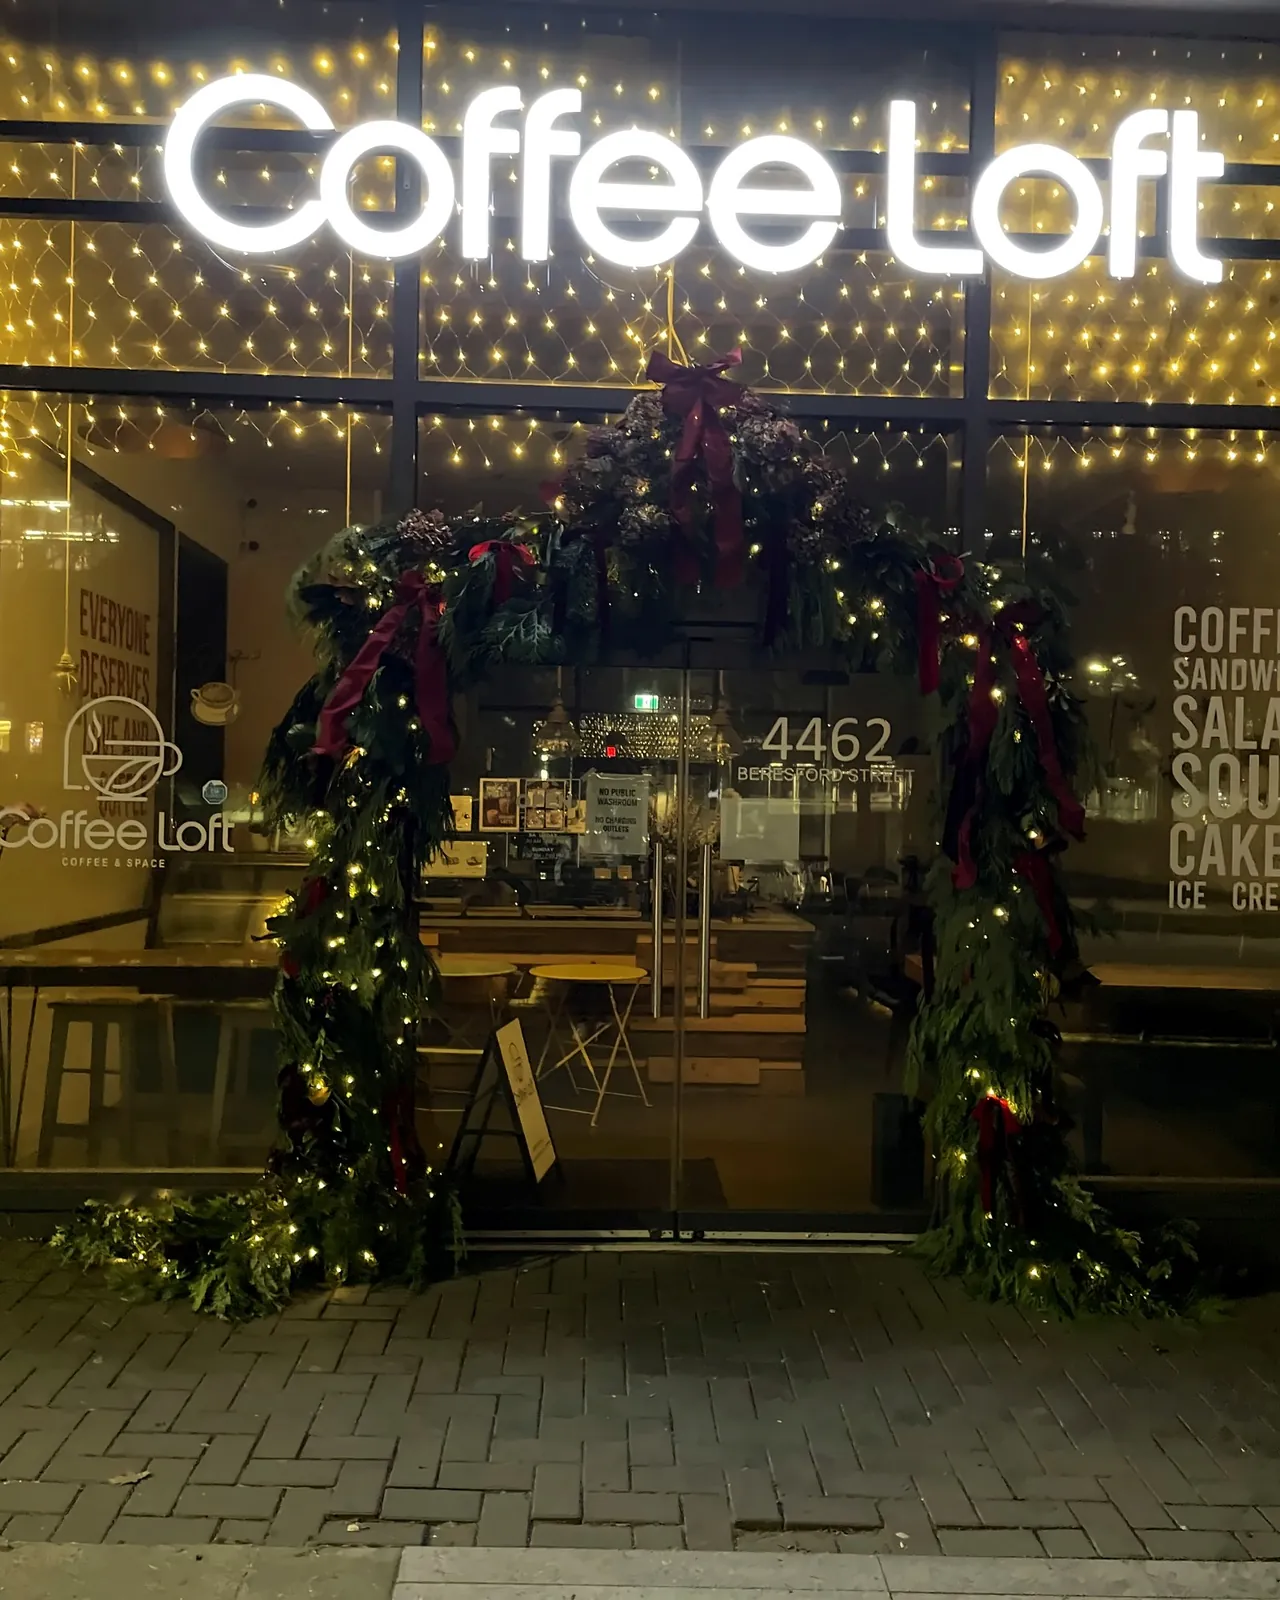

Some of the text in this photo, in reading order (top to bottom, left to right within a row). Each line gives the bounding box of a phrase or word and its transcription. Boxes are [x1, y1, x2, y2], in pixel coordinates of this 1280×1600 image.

[163, 71, 1225, 285] Coffee Loft
[80, 588, 151, 656] EVERYONE
[1173, 605, 1280, 654] COFF
[80, 649, 150, 707] DESERVES
[762, 716, 893, 762] 4462
[1172, 694, 1280, 750] SALA
[599, 788, 636, 797] NO PUBLIC
[737, 766, 915, 784] BERESFORD STREET
[1171, 752, 1280, 820] SOU
[595, 816, 604, 824] NO
[597, 797, 638, 806] WASHROOM
[0, 809, 235, 853] Coffee Loft
[602, 825, 629, 833] OUTLETS
[1169, 822, 1280, 877] CAKE
[62, 857, 166, 868] COFFEE & SPACE
[1168, 880, 1279, 911] ICE CRE
